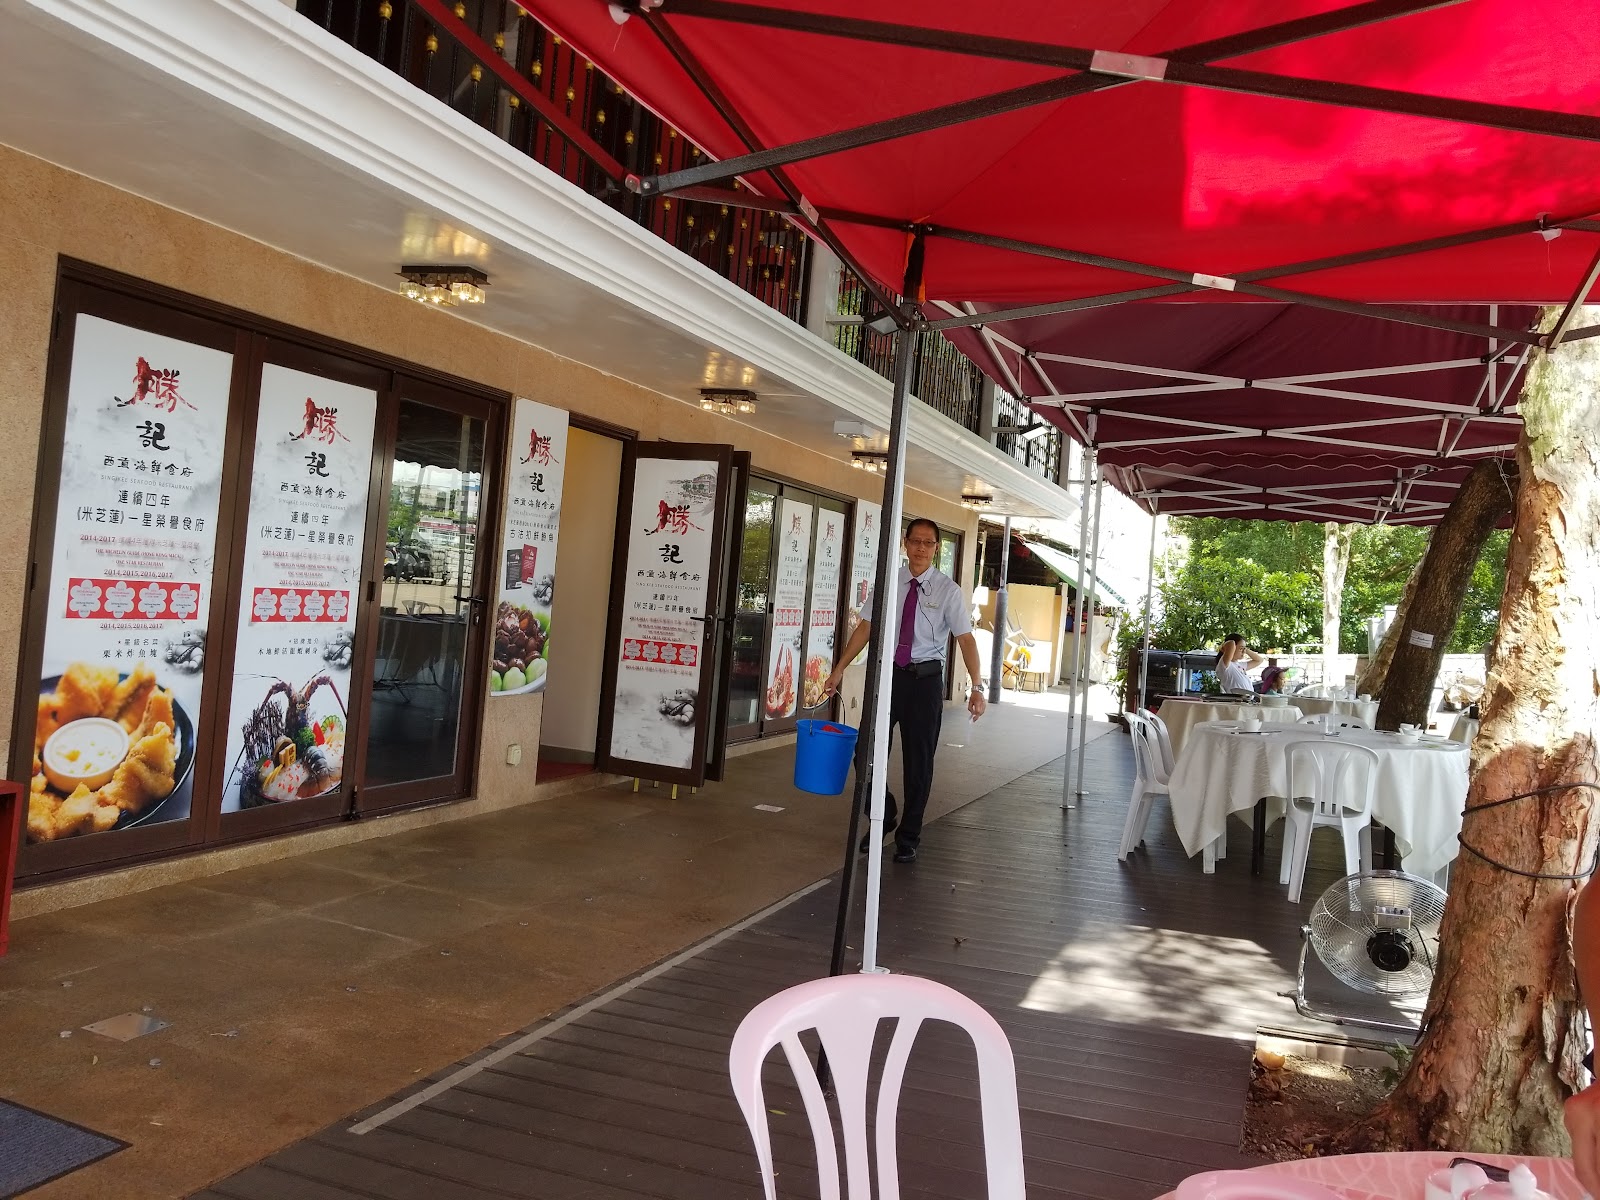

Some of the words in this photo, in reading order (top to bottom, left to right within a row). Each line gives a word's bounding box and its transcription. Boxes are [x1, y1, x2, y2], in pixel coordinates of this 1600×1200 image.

[136, 420, 170, 451] 記
[304, 451, 330, 477] 記
[529, 472, 546, 493] 記
[117, 489, 171, 508] 連續四年
[658, 543, 684, 564] 記
